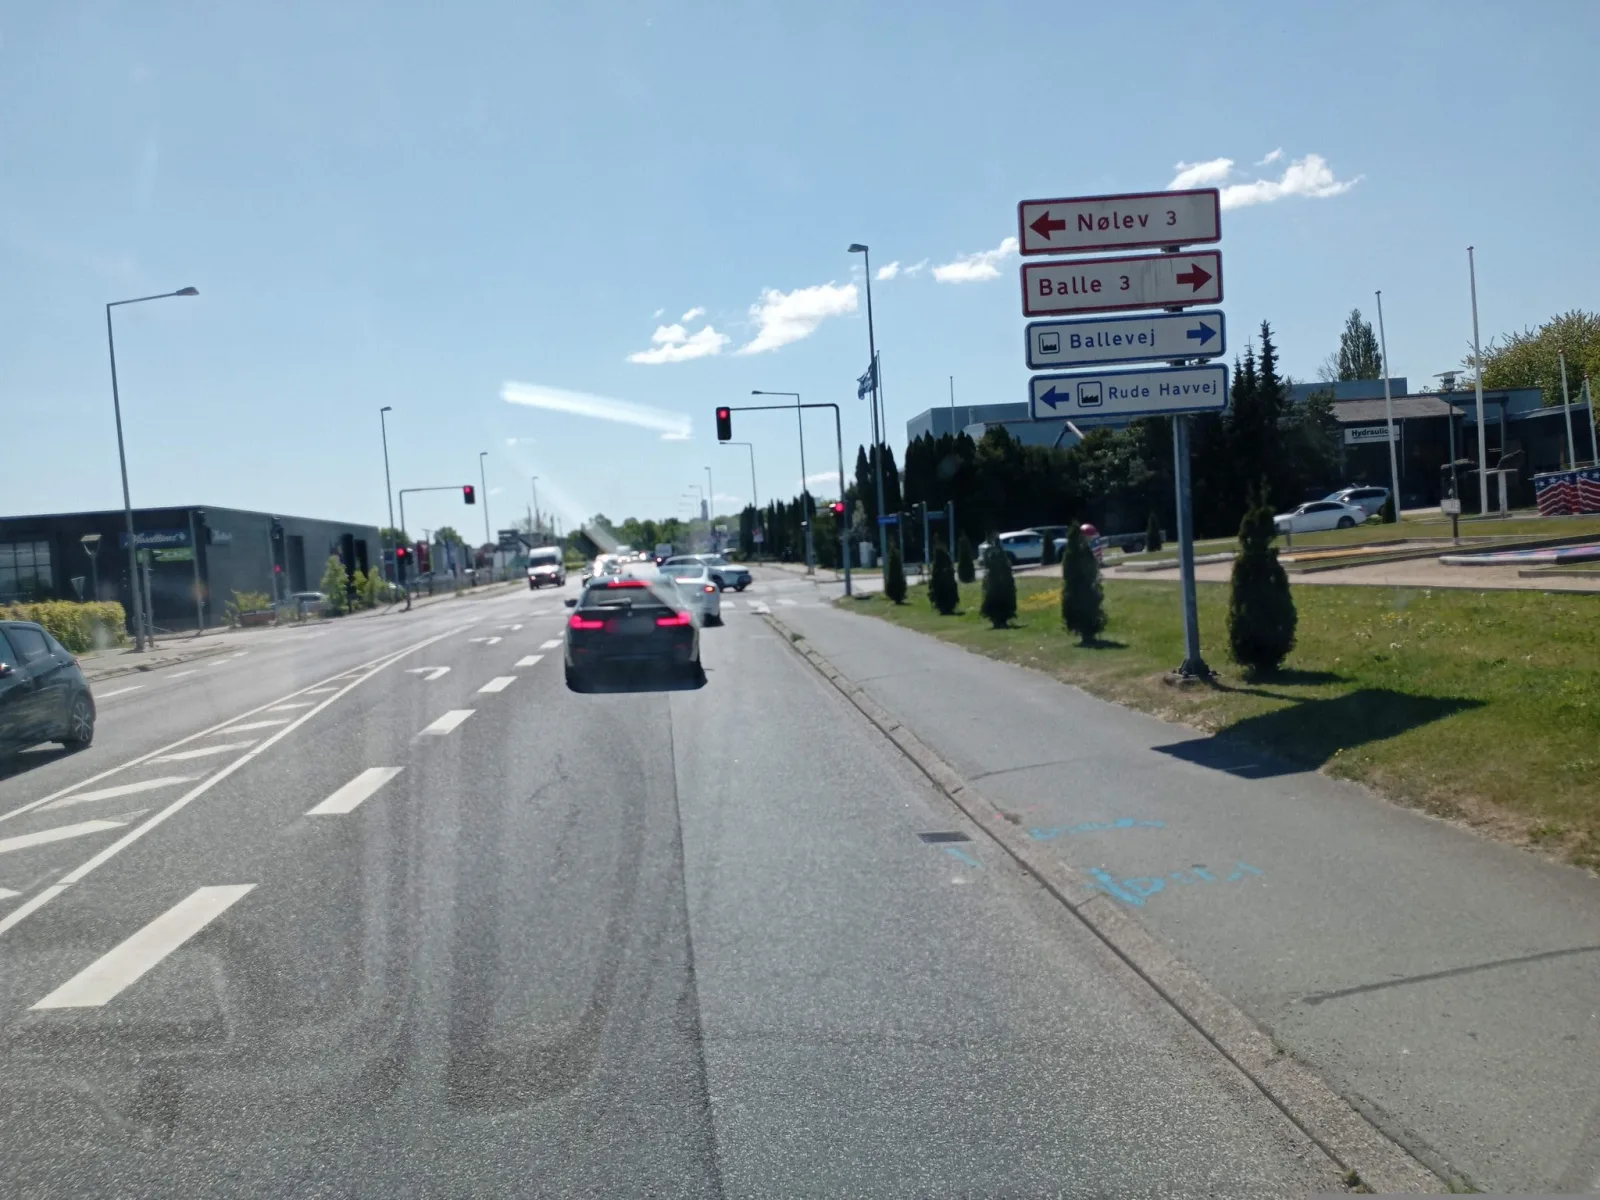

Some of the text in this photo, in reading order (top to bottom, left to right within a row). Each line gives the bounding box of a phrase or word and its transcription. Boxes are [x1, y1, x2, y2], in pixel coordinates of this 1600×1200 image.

[1077, 210, 1177, 232] Nølev 3
[1039, 275, 1130, 296] Balle 3
[1070, 328, 1156, 349] Ballevej
[1108, 380, 1217, 399] Rude Havvej
